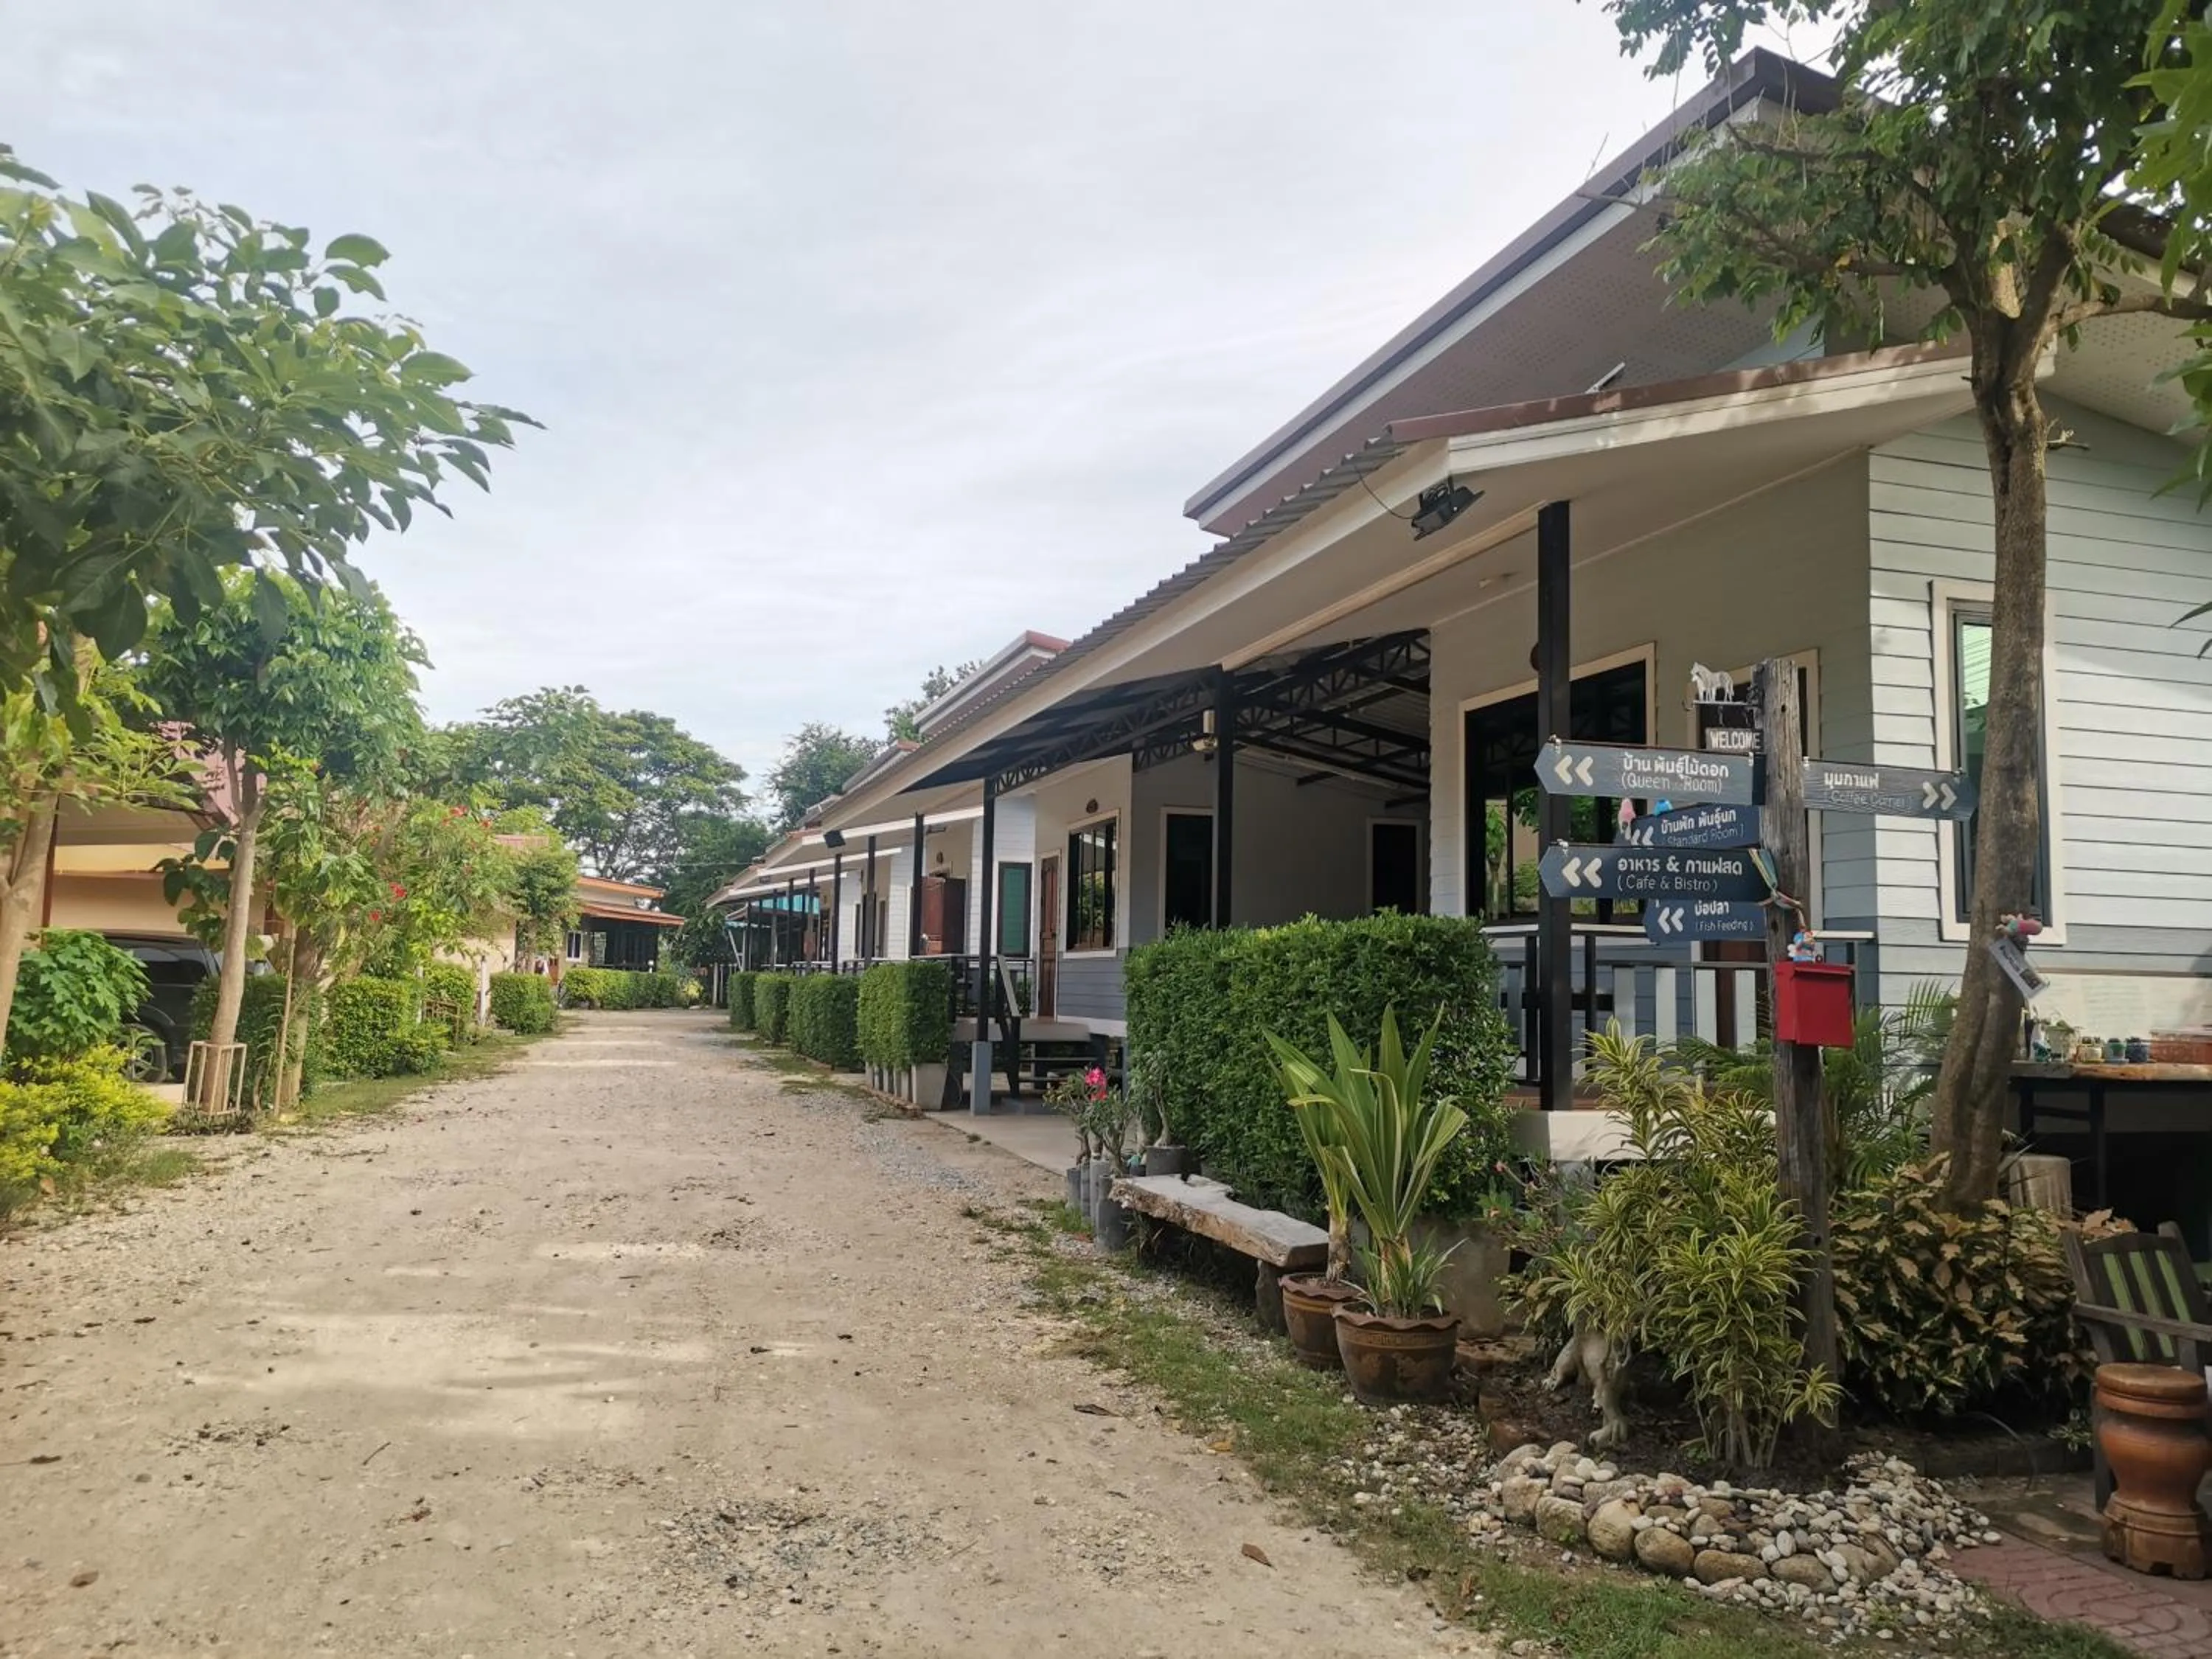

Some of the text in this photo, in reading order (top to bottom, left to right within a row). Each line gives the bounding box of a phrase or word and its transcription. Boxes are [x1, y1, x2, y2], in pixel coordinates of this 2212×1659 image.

[1710, 731, 1761, 749] WELCOME
[1824, 772, 1880, 790] มุมกาแฟ
[1618, 855, 1743, 875] อาหาร & กาแฟสด
[1660, 875, 1671, 890] &
[1694, 900, 1730, 916] บ่อปลา
